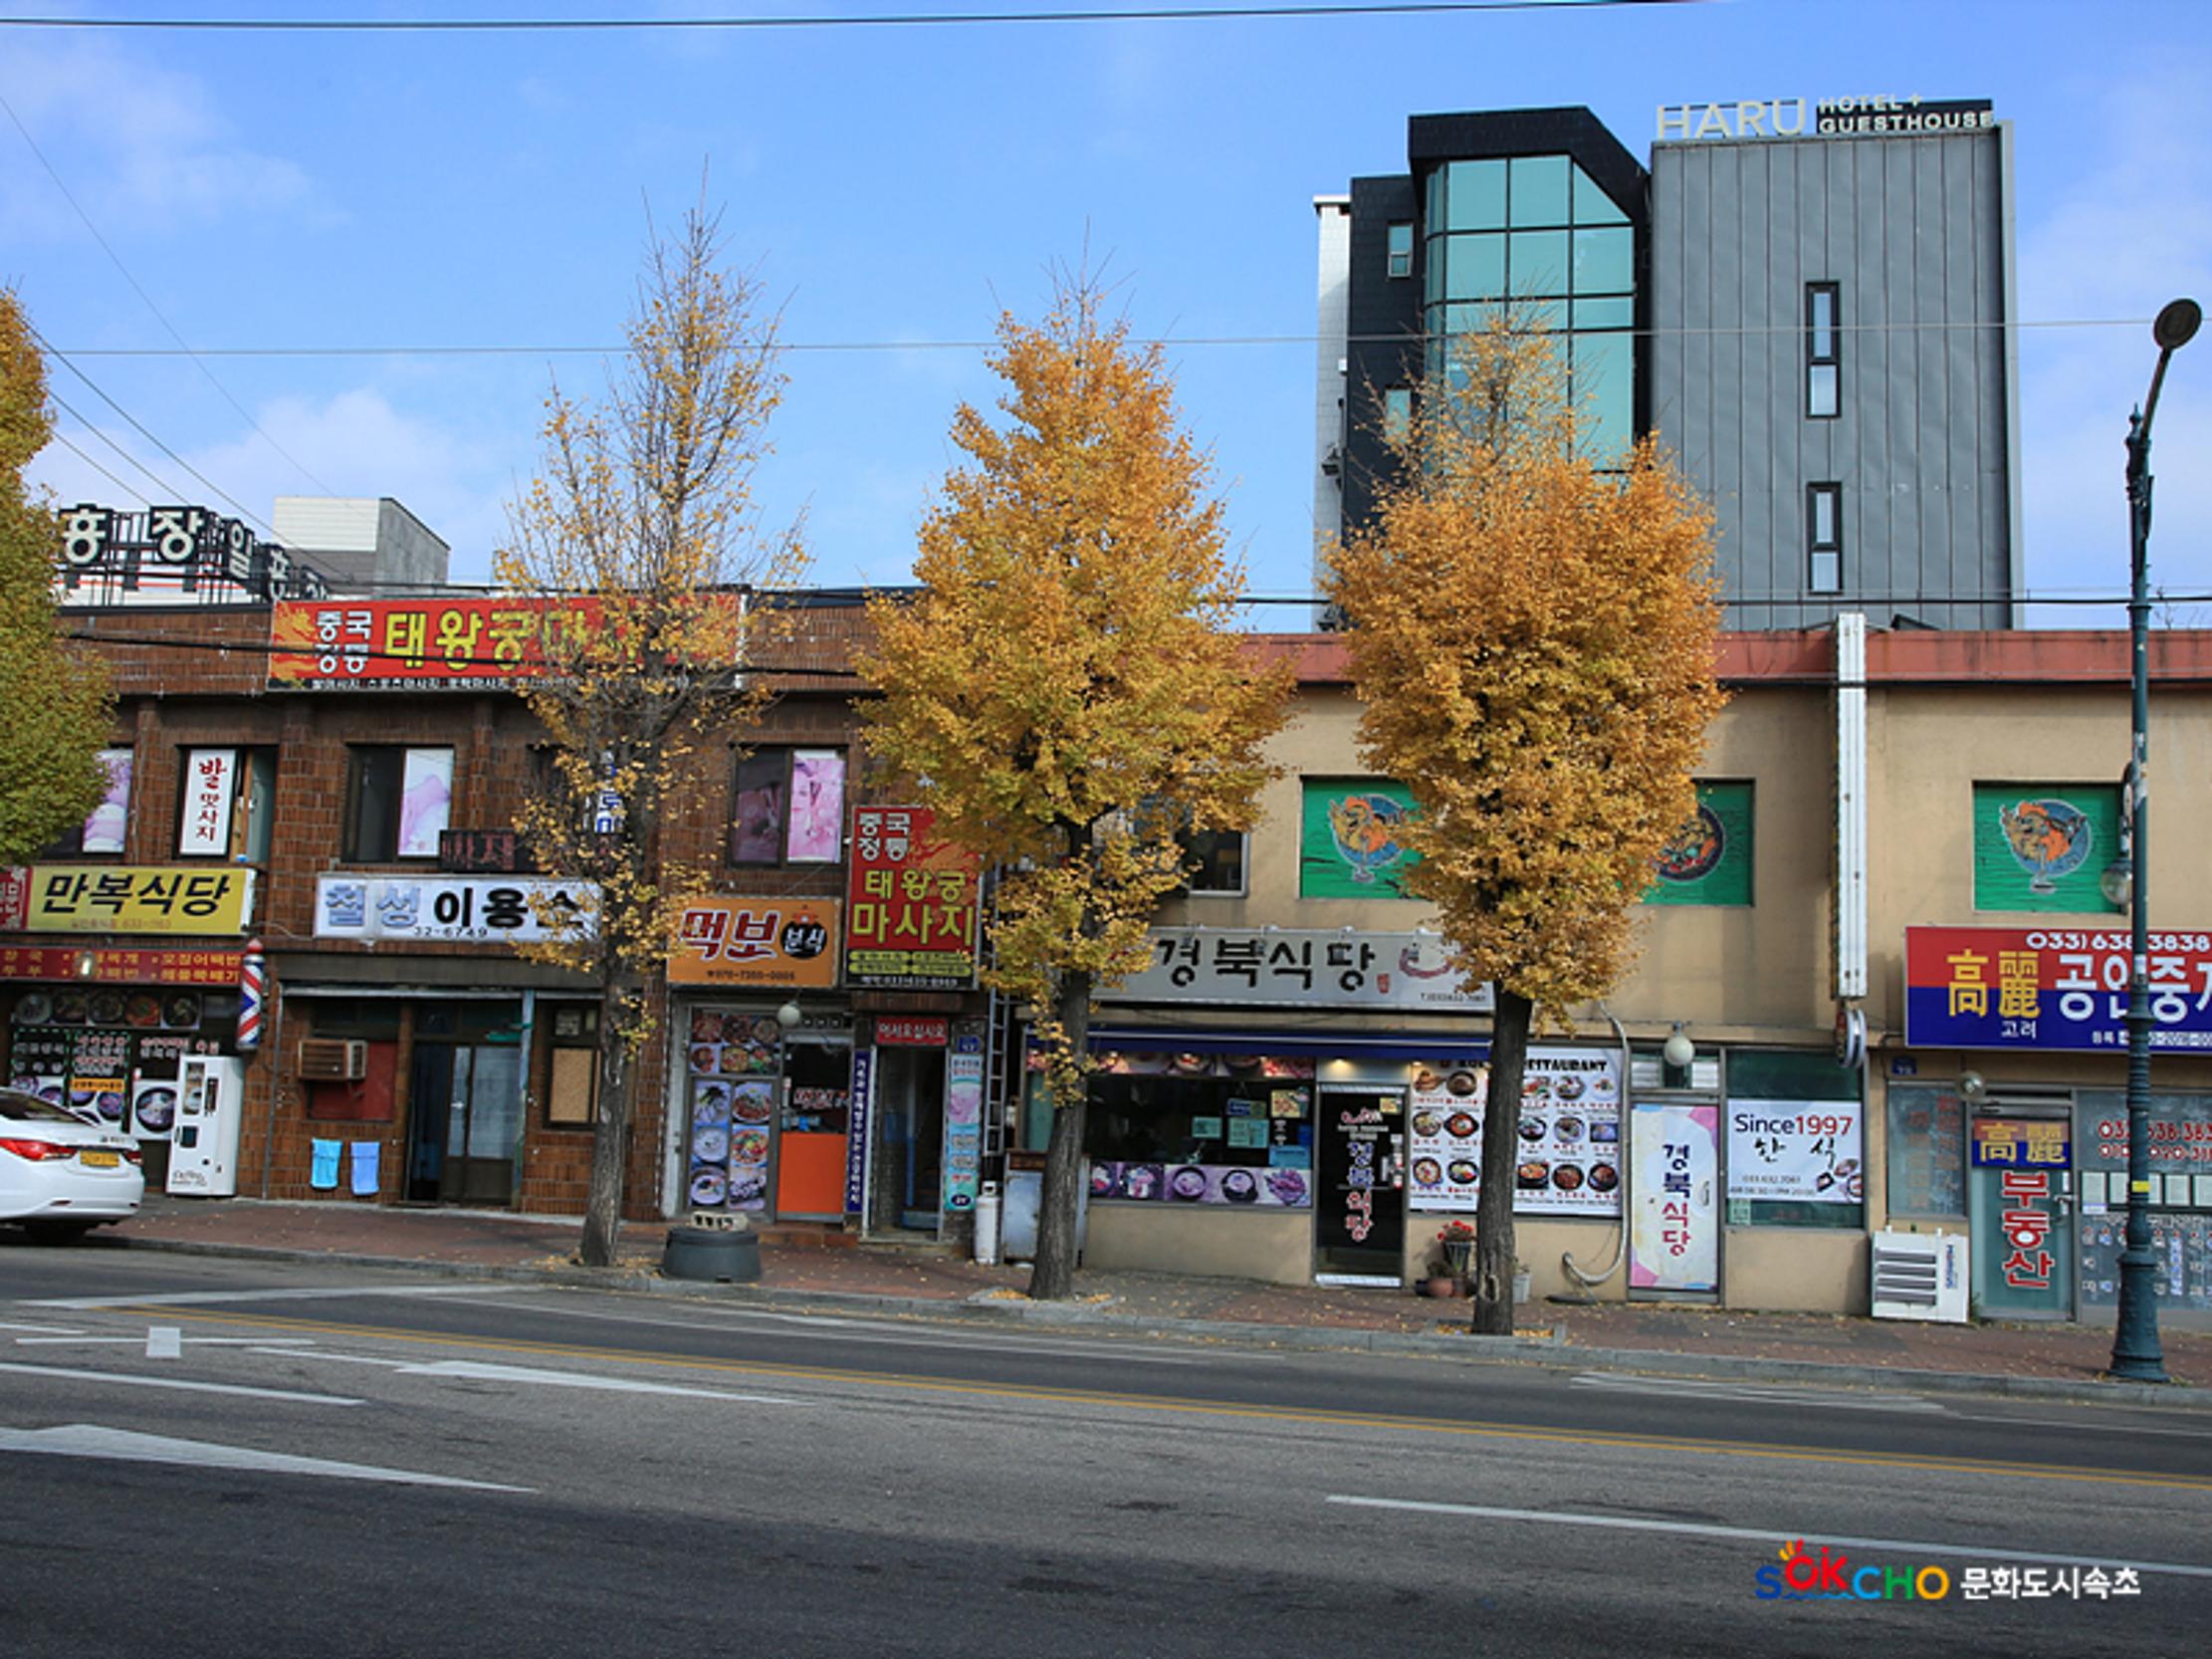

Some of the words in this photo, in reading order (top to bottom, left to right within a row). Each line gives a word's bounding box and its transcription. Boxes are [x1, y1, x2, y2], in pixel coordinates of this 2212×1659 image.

[1657, 99, 1805, 140] HARU
[1818, 94, 1903, 115] HOTEL
[1818, 111, 1995, 134] GUESTHOUSE
[317, 610, 371, 641] 중국
[859, 813, 911, 835] 중국
[858, 837, 909, 861] 정통
[42, 873, 230, 916] 만복식당
[864, 869, 967, 902] 태왕궁
[681, 911, 780, 961] 먹보
[852, 903, 975, 946] 마사지
[1158, 938, 1376, 992] 경북식당
[1946, 948, 2041, 1018] 高麗
[2001, 1021, 2037, 1039] 고려
[1734, 1113, 1854, 1136] Since1997
[1979, 1122, 2067, 1164] 高麗
[1661, 1144, 1692, 1258] 경북식당
[2002, 1170, 2056, 1289] 부동산
